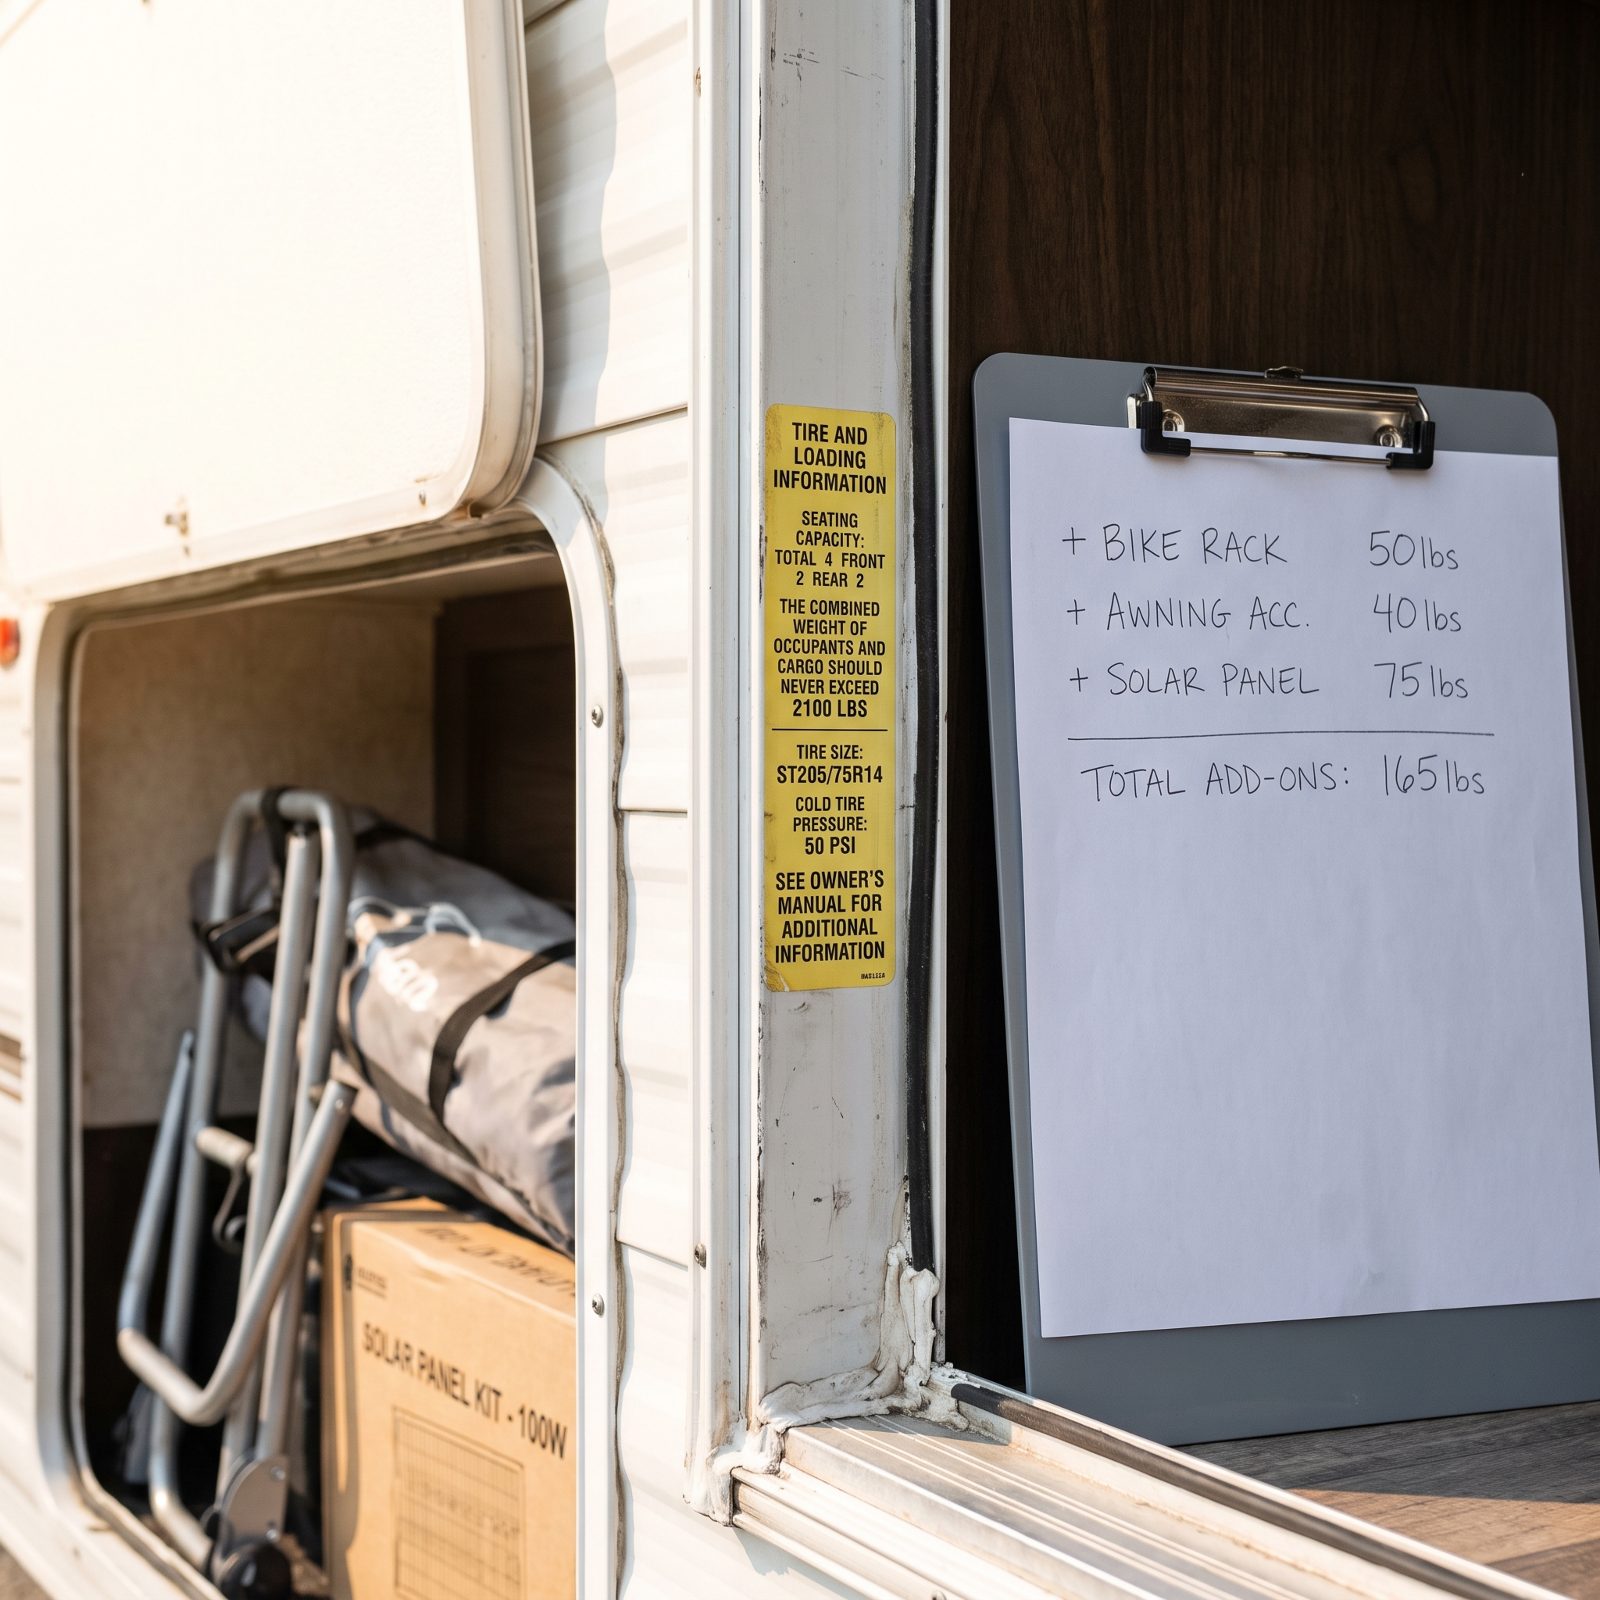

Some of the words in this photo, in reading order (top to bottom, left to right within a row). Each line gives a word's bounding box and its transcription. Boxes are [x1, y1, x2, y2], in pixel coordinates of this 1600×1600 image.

[792, 422, 828, 442] TIRE
[834, 426, 867, 445] AND
[794, 447, 866, 469] LOADING
[774, 467, 886, 494] INFORMATION
[802, 511, 857, 528] SEATING
[796, 530, 864, 548] CAPACITY:
[1103, 524, 1181, 562] BIKE
[1202, 528, 1287, 565] RACK
[775, 550, 816, 565] TOTAL
[825, 552, 832, 566] 4
[842, 553, 885, 568] FRONT
[797, 571, 803, 585] 2
[813, 572, 847, 587] REAR
[857, 574, 863, 587] 2
[780, 599, 805, 614] THE
[810, 600, 879, 616] COMBINED
[1107, 592, 1231, 630] AWNING
[1250, 597, 1308, 630] ACC.
[793, 619, 845, 635] WEIGHT
[850, 621, 867, 635] OF
[774, 638, 853, 655] OCCUPANTS
[859, 641, 885, 655] AND
[778, 659, 823, 674] CARGO
[829, 660, 882, 675] SHOULD
[781, 679, 824, 694] NEVER
[830, 680, 878, 695] EXCEED
[1108, 663, 1205, 695] SOLAR
[1222, 663, 1319, 696] PANEL
[793, 699, 831, 717] 2100
[838, 700, 867, 717] LBS
[797, 745, 826, 759] TIRE
[831, 745, 862, 759] SIZE:
[777, 765, 882, 784] ST205/75R14
[1081, 765, 1185, 801] TOTAL
[1206, 762, 1348, 795] ADD-ONS:
[796, 797, 830, 811] COLD
[836, 797, 864, 811] TIRE
[794, 817, 866, 832] PRESSURE:
[805, 837, 823, 855] 50
[830, 836, 855, 854] PSI
[776, 872, 805, 890] SEE
[779, 895, 846, 914] MANUAL
[852, 894, 881, 912] FOR
[782, 918, 877, 938] ADDITIONAL
[776, 941, 884, 963] INFORMATION
[362, 1321, 414, 1377] SOLAR
[417, 1349, 471, 1407] PANEL
[473, 1377, 503, 1423] KIT
[518, 1403, 568, 1460] 100W
